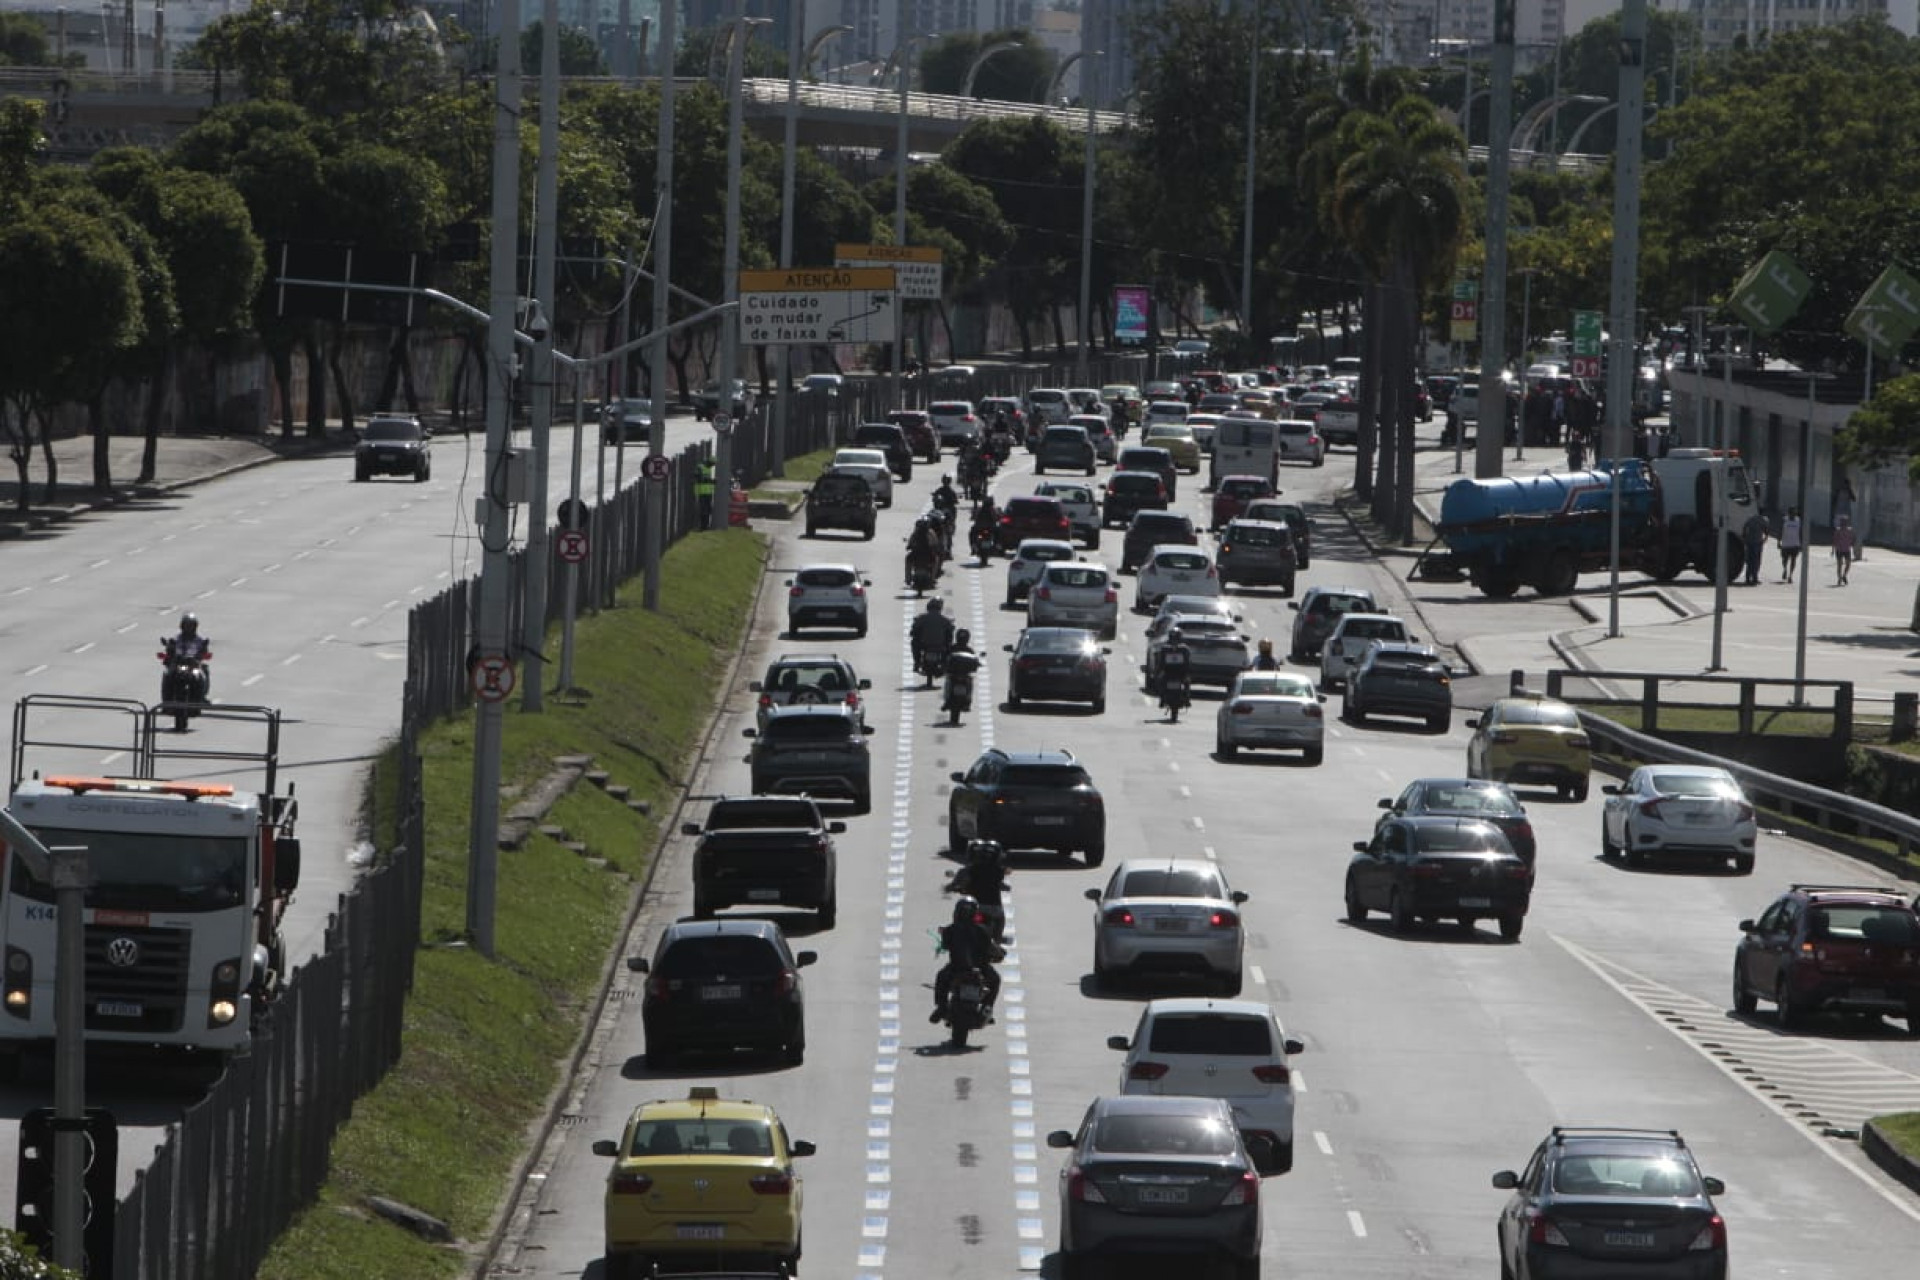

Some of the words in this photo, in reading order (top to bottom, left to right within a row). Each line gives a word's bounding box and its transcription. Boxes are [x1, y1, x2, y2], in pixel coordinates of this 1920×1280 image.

[785, 271, 852, 289] ATENÇÃO
[748, 295, 820, 309] Cuidado
[744, 313, 763, 324] ao
[770, 311, 823, 325] mudar
[750, 327, 769, 340] de
[776, 327, 818, 340] faixa
